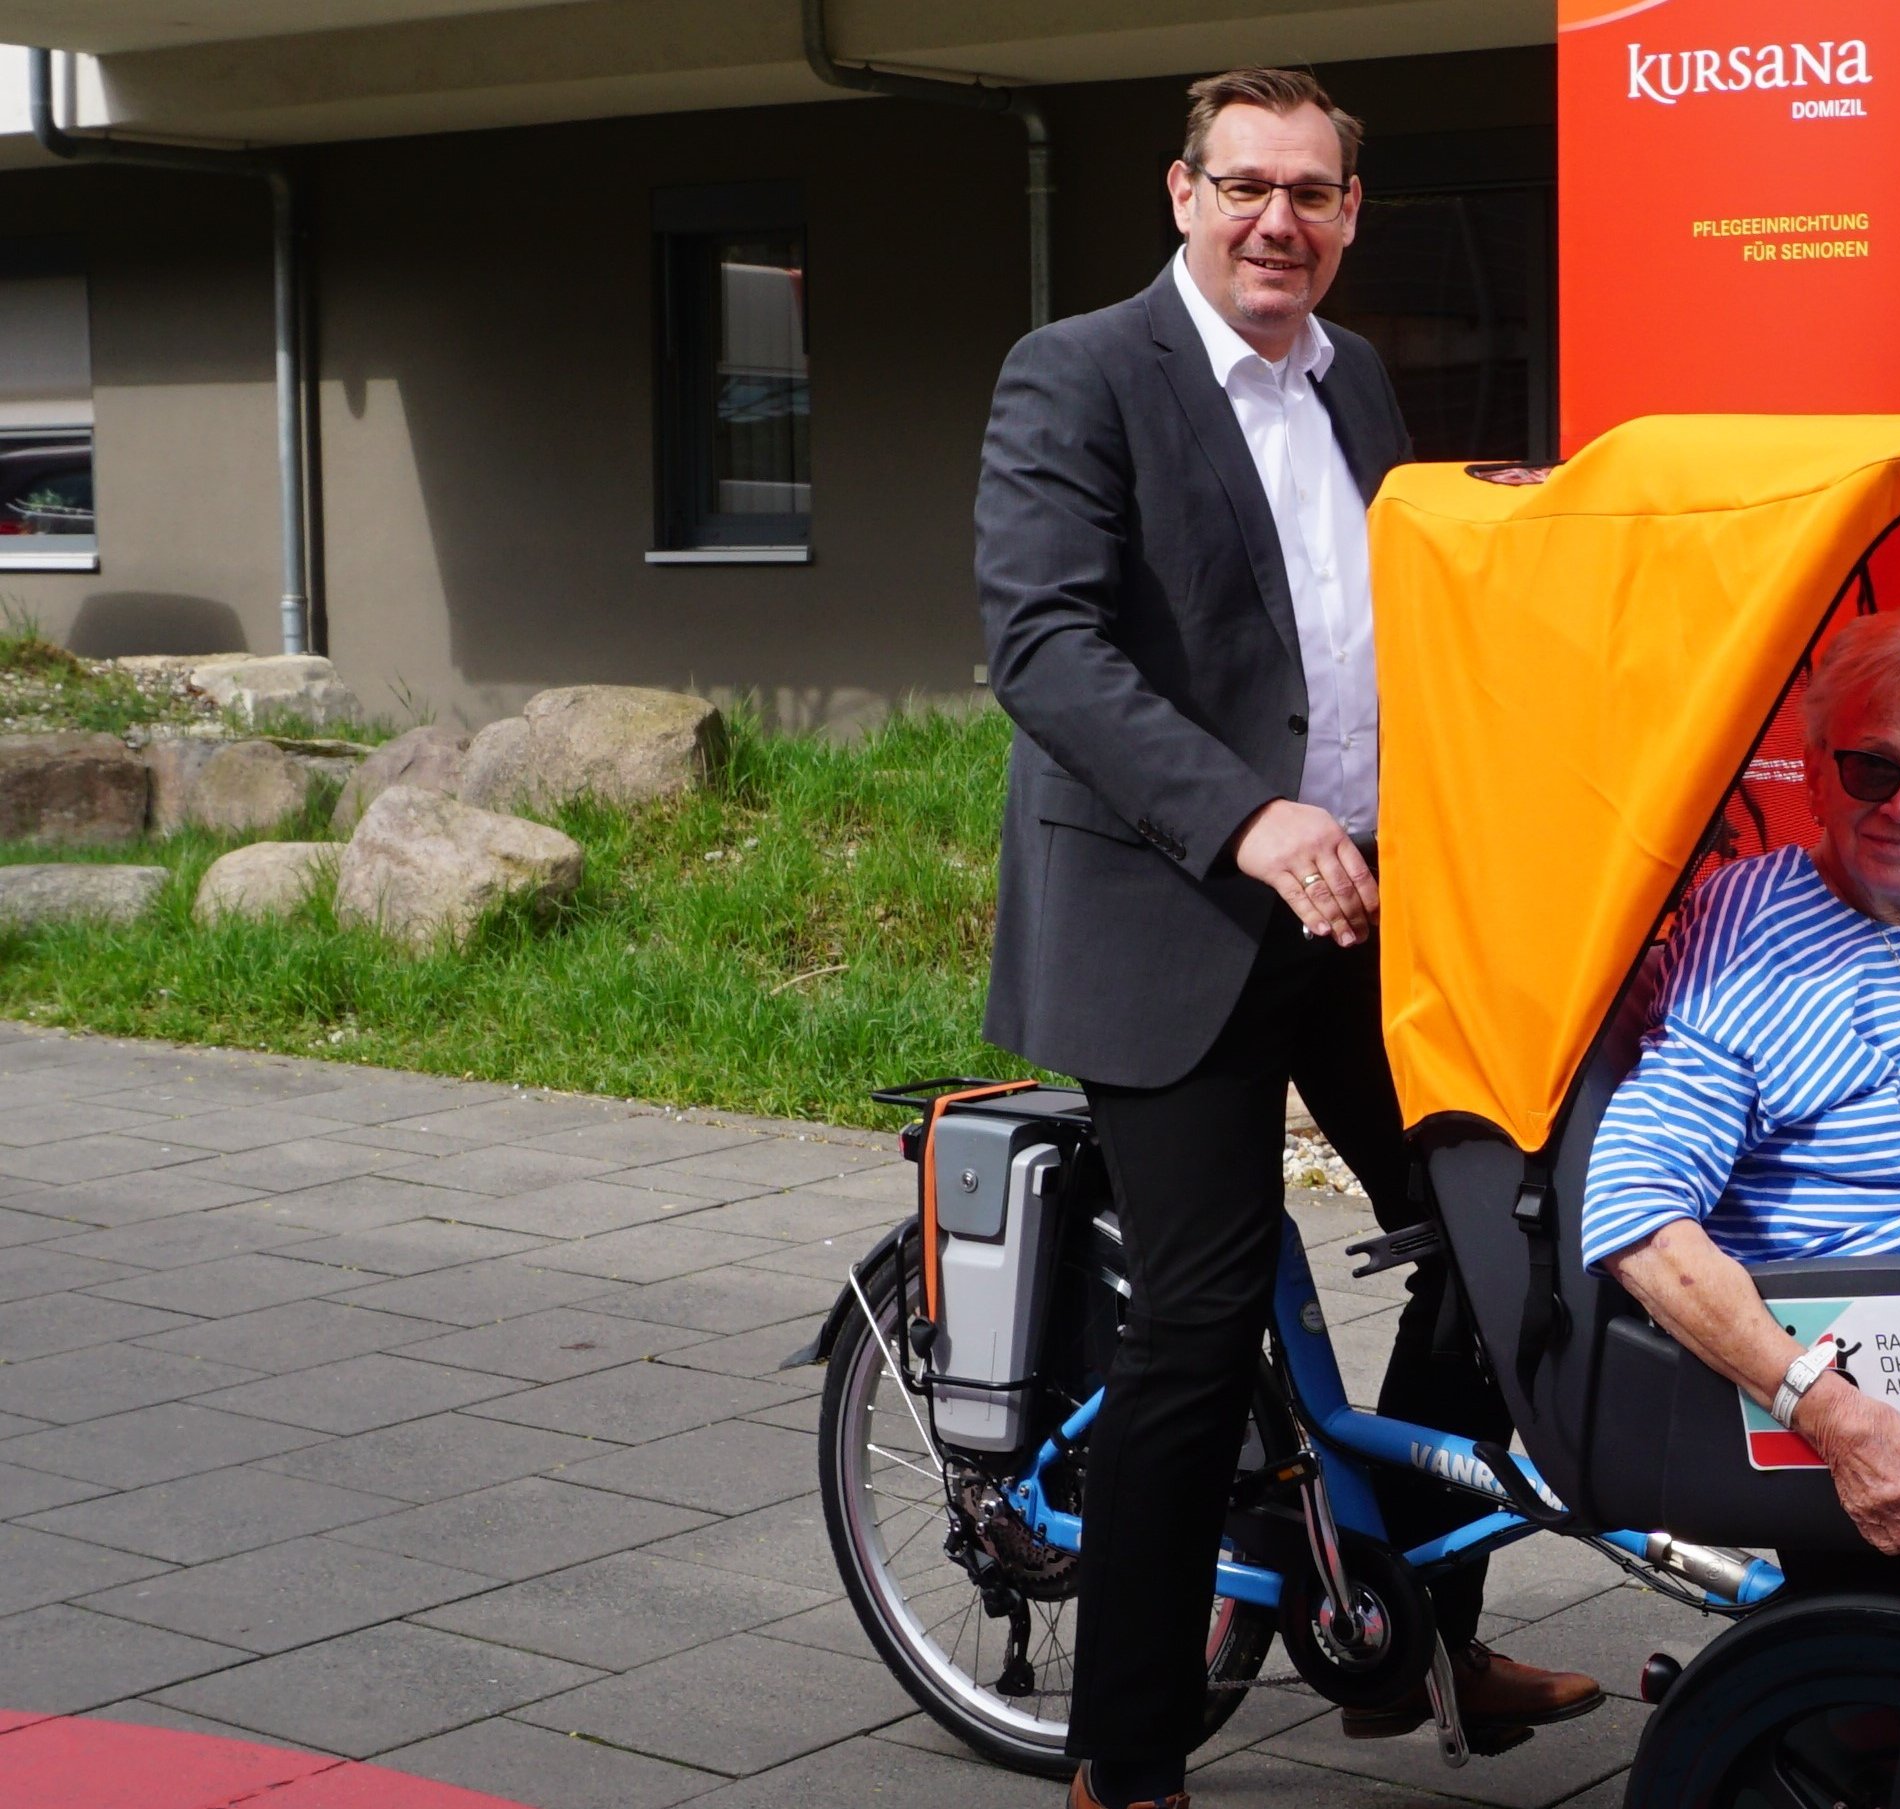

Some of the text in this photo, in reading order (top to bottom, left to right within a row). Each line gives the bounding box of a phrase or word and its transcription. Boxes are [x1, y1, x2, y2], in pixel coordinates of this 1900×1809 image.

[1792, 99, 1867, 119] DOMIZIL
[1693, 213, 1869, 238] PFLEGEEINRICHTUNG
[1744, 241, 1869, 262] FÜR SENIOREN
[1411, 1441, 1569, 1512] VANRM
